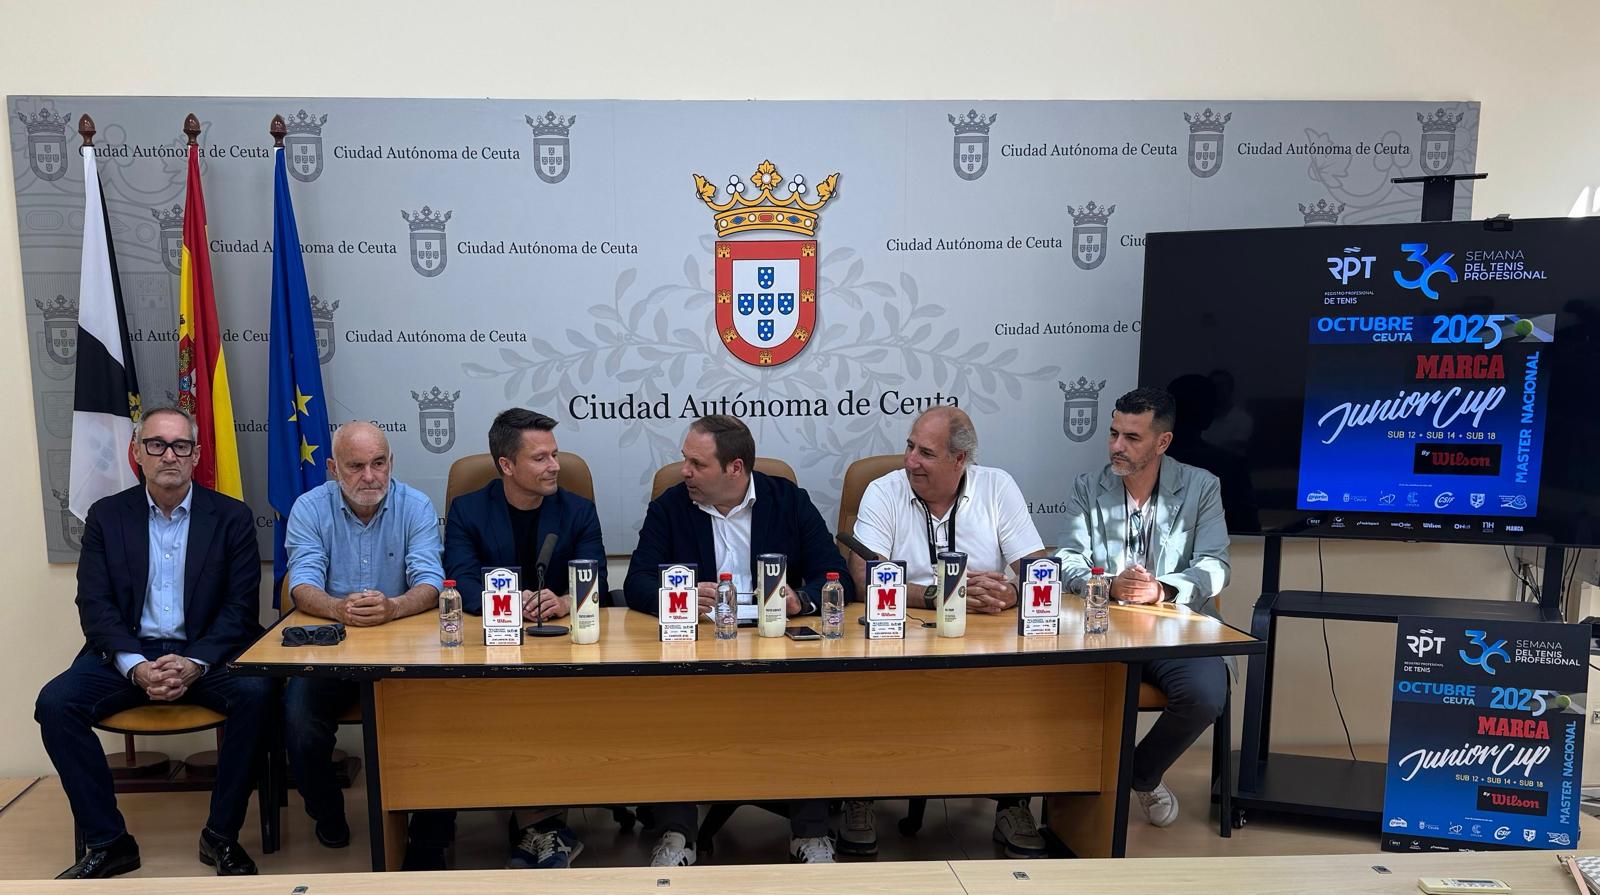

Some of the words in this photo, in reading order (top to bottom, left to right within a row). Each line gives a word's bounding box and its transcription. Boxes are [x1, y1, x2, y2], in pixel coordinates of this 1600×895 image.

[79, 144, 128, 158] Cudad
[133, 144, 206, 158] Autónoa
[209, 144, 226, 158] de
[229, 145, 269, 158] Ceuta
[333, 145, 383, 160] Ciudad
[386, 145, 458, 160] Autónoma
[461, 146, 478, 160] de
[481, 147, 520, 160] Ceuta
[1001, 143, 1047, 157] Ciudad
[1051, 143, 1119, 157] Autónoma
[1122, 142, 1138, 156] de
[1140, 142, 1178, 156] Ceuta
[1237, 142, 1283, 155] Ciudad
[1286, 142, 1352, 155] Autónoma
[1355, 142, 1371, 155] de
[1374, 142, 1410, 155] Ceuta
[210, 240, 258, 253] Ciudad
[263, 240, 334, 253] Anoma
[337, 240, 354, 253] de
[358, 241, 397, 254] Ceuta
[457, 241, 506, 255] Ciudad
[508, 240, 580, 255] Autónoma
[582, 241, 598, 255] de
[600, 242, 638, 255] Ceuta
[887, 238, 932, 251] Ciudad
[936, 237, 1003, 251] Autónoma
[1006, 237, 1022, 249] de
[1025, 236, 1062, 249] Ceuta
[1465, 250, 1525, 262] SEMANA
[1327, 255, 1377, 285] RPT
[1464, 262, 1487, 272] DEL
[1491, 261, 1524, 271] TENIS
[1463, 270, 1548, 281] PROFESIONAL
[1324, 297, 1335, 305] DE
[1336, 297, 1358, 305] TENIS
[995, 322, 1040, 336] Ciudad
[1043, 321, 1110, 334] Autónoma
[1113, 320, 1128, 333] de
[1317, 316, 1414, 332] OCTUBRE
[1431, 314, 1506, 350] 2025
[222, 329, 239, 342] de
[243, 330, 270, 342] Ceu
[345, 329, 393, 343] Ciudad
[397, 329, 466, 343] Autónoma
[470, 329, 487, 343] de
[489, 330, 526, 343] Ceuta
[1372, 333, 1413, 342] CEUTA
[1415, 355, 1505, 379] MARCA
[1521, 351, 1540, 424] NACIONAL
[568, 393, 670, 420] Ciudad
[679, 391, 829, 418] Autónoma
[837, 390, 870, 416] de
[879, 390, 959, 415] Ceuta
[1387, 431, 1405, 439] SUB
[1407, 431, 1416, 439] 12
[1426, 431, 1444, 440] SUB
[1447, 431, 1456, 440] 14
[1466, 431, 1485, 440] SUB
[1487, 431, 1496, 440] 18
[1432, 452, 1491, 467] Wilson
[1515, 428, 1532, 484] MASTER
[577, 568, 593, 582] W
[765, 563, 780, 577] W
[946, 563, 960, 576] W
[1032, 568, 1054, 581] RPT
[491, 578, 512, 591] RPT
[667, 575, 689, 588] RPT
[876, 572, 898, 585] RPT
[669, 592, 688, 613] M
[877, 588, 897, 610] M
[1032, 585, 1052, 607] M
[492, 595, 512, 616] M
[1406, 635, 1447, 658] RPT
[1516, 639, 1563, 650] SEMANA
[1515, 649, 1533, 657] DEL
[1535, 650, 1562, 658] TENIS
[1515, 655, 1581, 667] PROFESIONAL
[1398, 681, 1476, 697] OCTUBRE
[1489, 687, 1549, 717] 2025
[1443, 696, 1476, 706] CEUTA
[1477, 716, 1550, 740] MARCA
[1563, 720, 1577, 778] NACIONAL
[1455, 774, 1470, 782] SUB
[1472, 775, 1479, 783] 12
[1487, 777, 1502, 785] SUB
[1519, 779, 1534, 787] SUB
[1491, 792, 1540, 809] Wilson
[1560, 780, 1573, 825] MASTER
